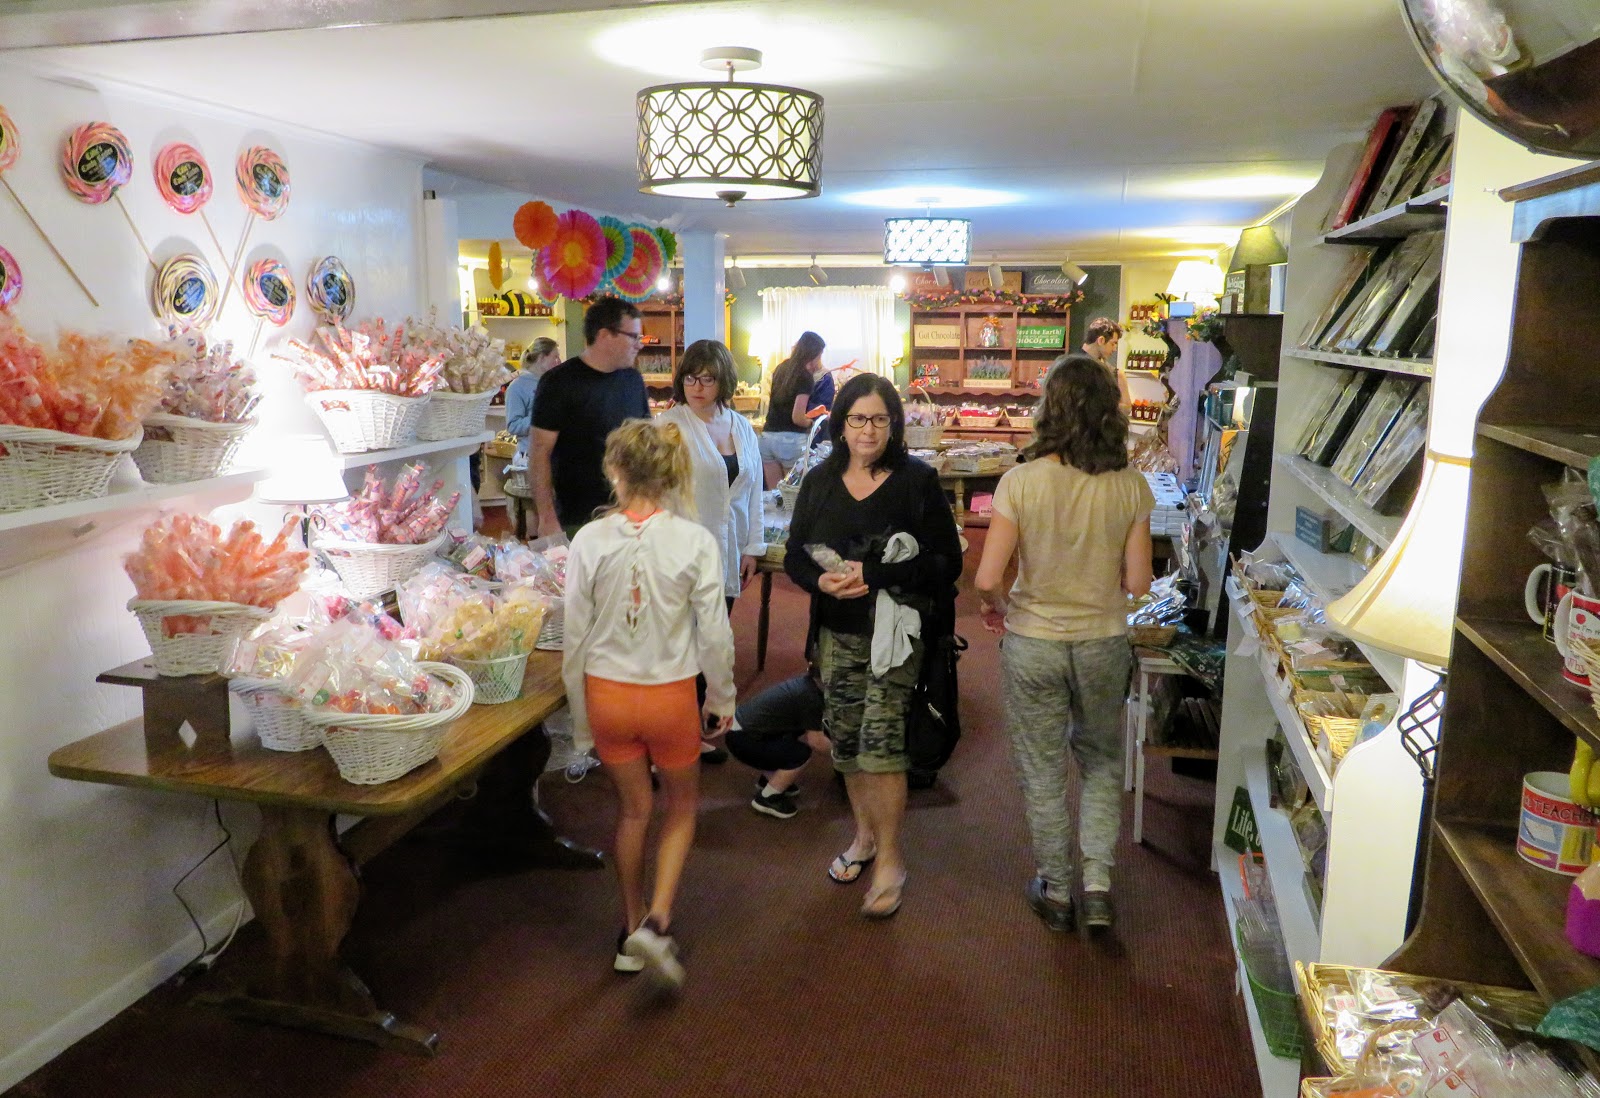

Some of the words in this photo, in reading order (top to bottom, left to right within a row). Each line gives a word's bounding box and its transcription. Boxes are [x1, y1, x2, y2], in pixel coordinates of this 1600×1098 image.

[1033, 274, 1070, 285] Chocolate
[918, 331, 930, 340] Got
[931, 330, 961, 340] Chocolate
[1231, 804, 1254, 842] Life,
